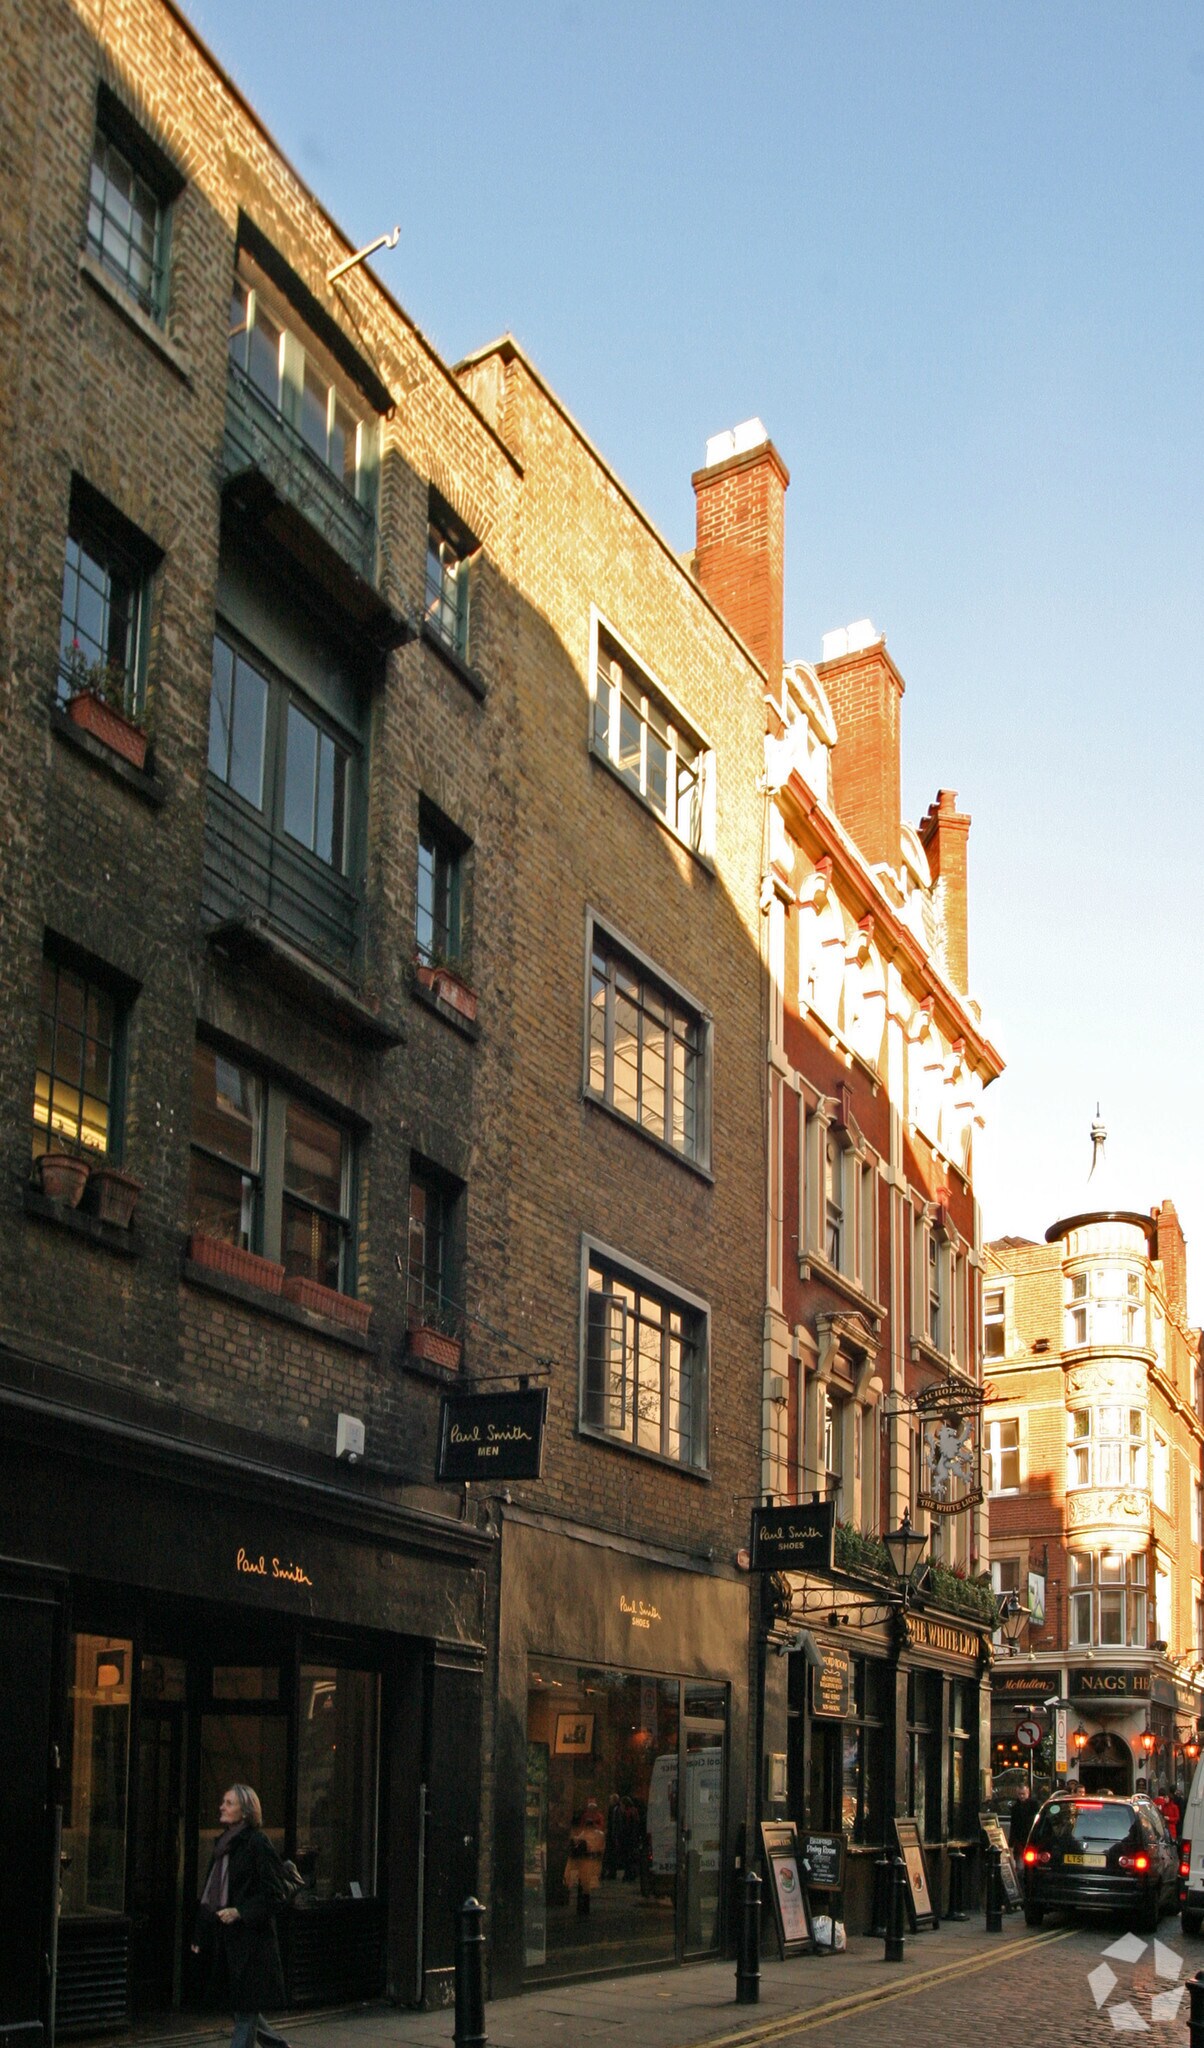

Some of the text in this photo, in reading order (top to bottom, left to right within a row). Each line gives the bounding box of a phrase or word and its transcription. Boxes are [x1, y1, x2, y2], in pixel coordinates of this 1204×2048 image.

[918, 1387, 983, 1403] NICHOLSON'S
[451, 1424, 532, 1443] Paul Smith
[477, 1446, 500, 1457] MEN
[920, 1494, 980, 1512] THE WHITE LION
[760, 1525, 823, 1541] Paul Smith
[778, 1541, 805, 1551] SHOES
[237, 1547, 313, 1586] Paul Smith
[620, 1595, 662, 1620] Paul Smith
[631, 1616, 650, 1629] SHOES
[928, 1621, 959, 1651] WHITE
[959, 1631, 980, 1657] LION
[1081, 1676, 1127, 1690] NAGS
